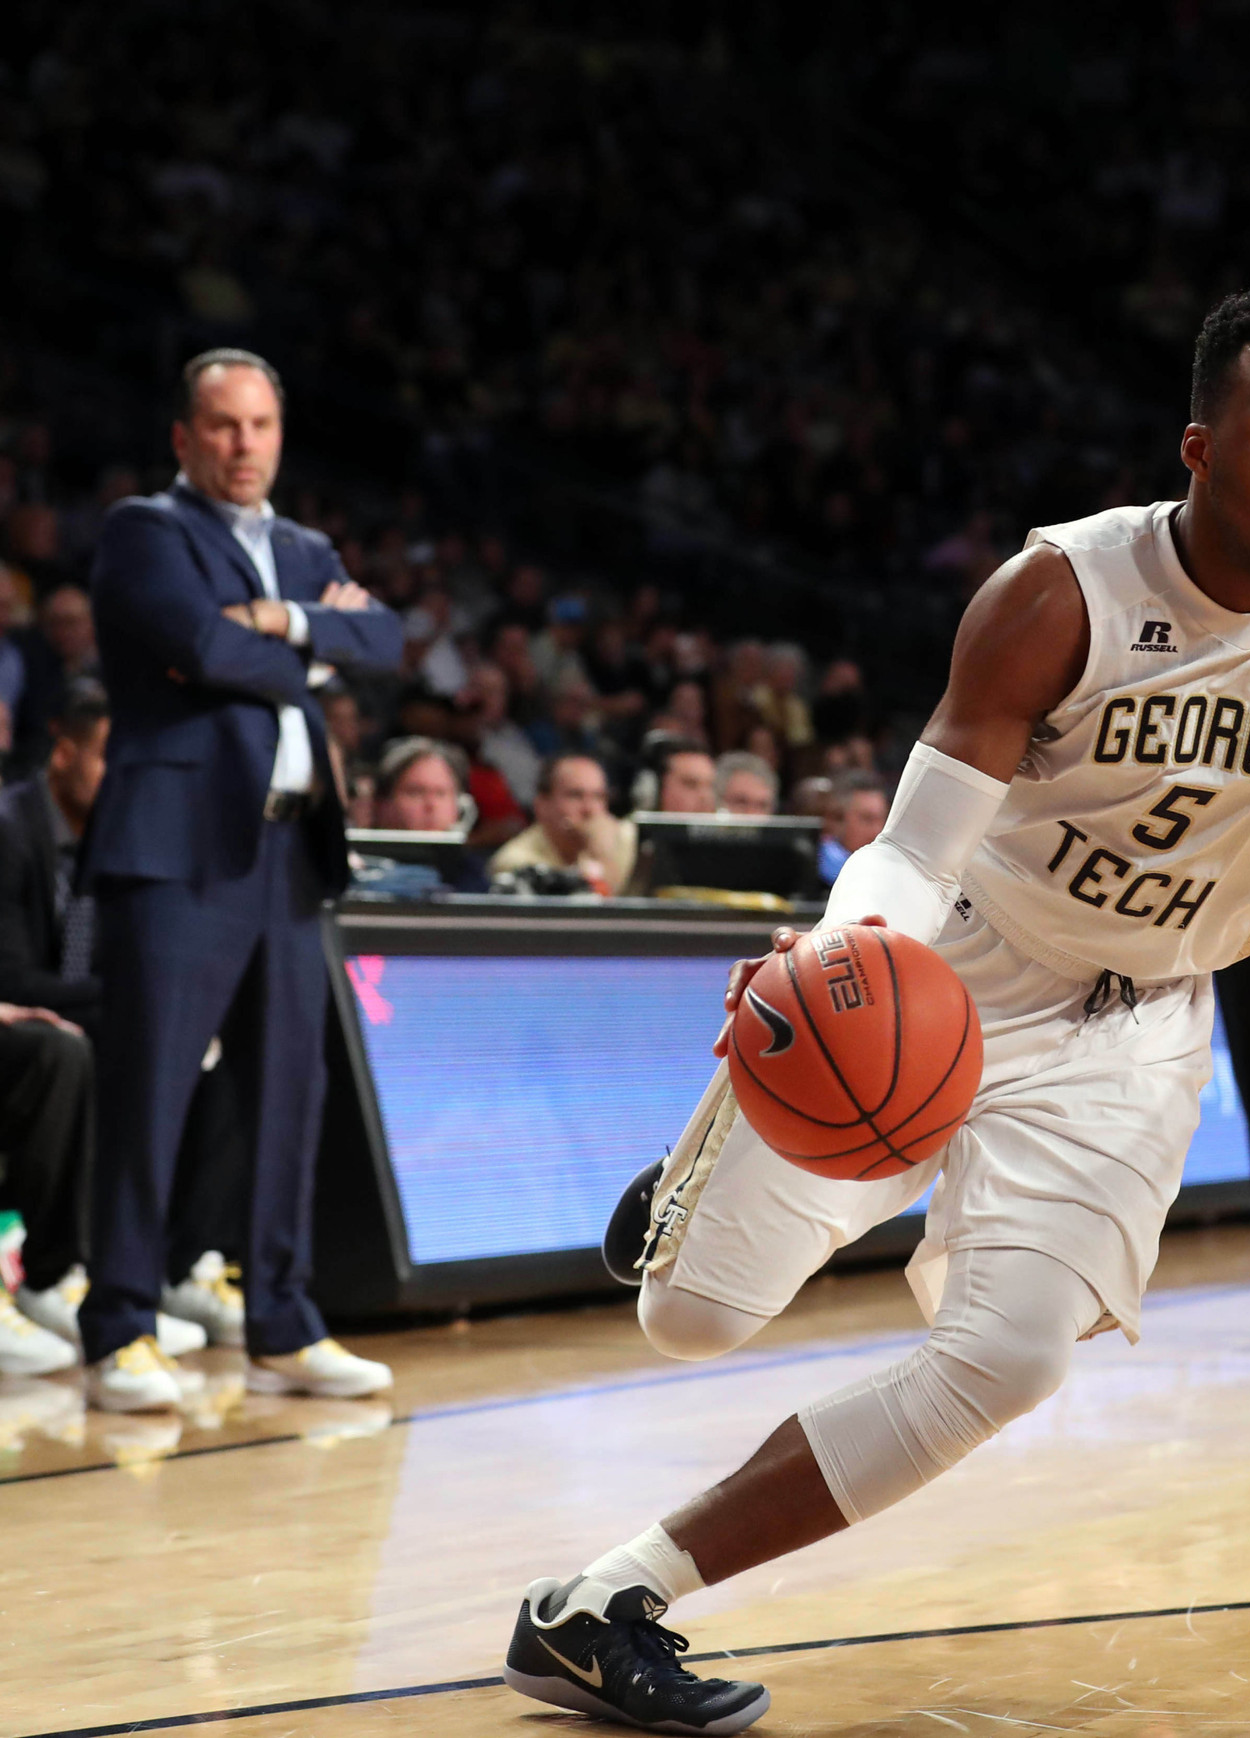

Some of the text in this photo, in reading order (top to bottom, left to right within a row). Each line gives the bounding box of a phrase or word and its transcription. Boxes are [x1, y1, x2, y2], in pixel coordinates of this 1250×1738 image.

[1130, 643, 1179, 653] RUSSELL
[1138, 620, 1172, 643] R
[1131, 783, 1220, 851] 5
[1047, 818, 1217, 930] TECH
[810, 930, 865, 1014] ELITE
